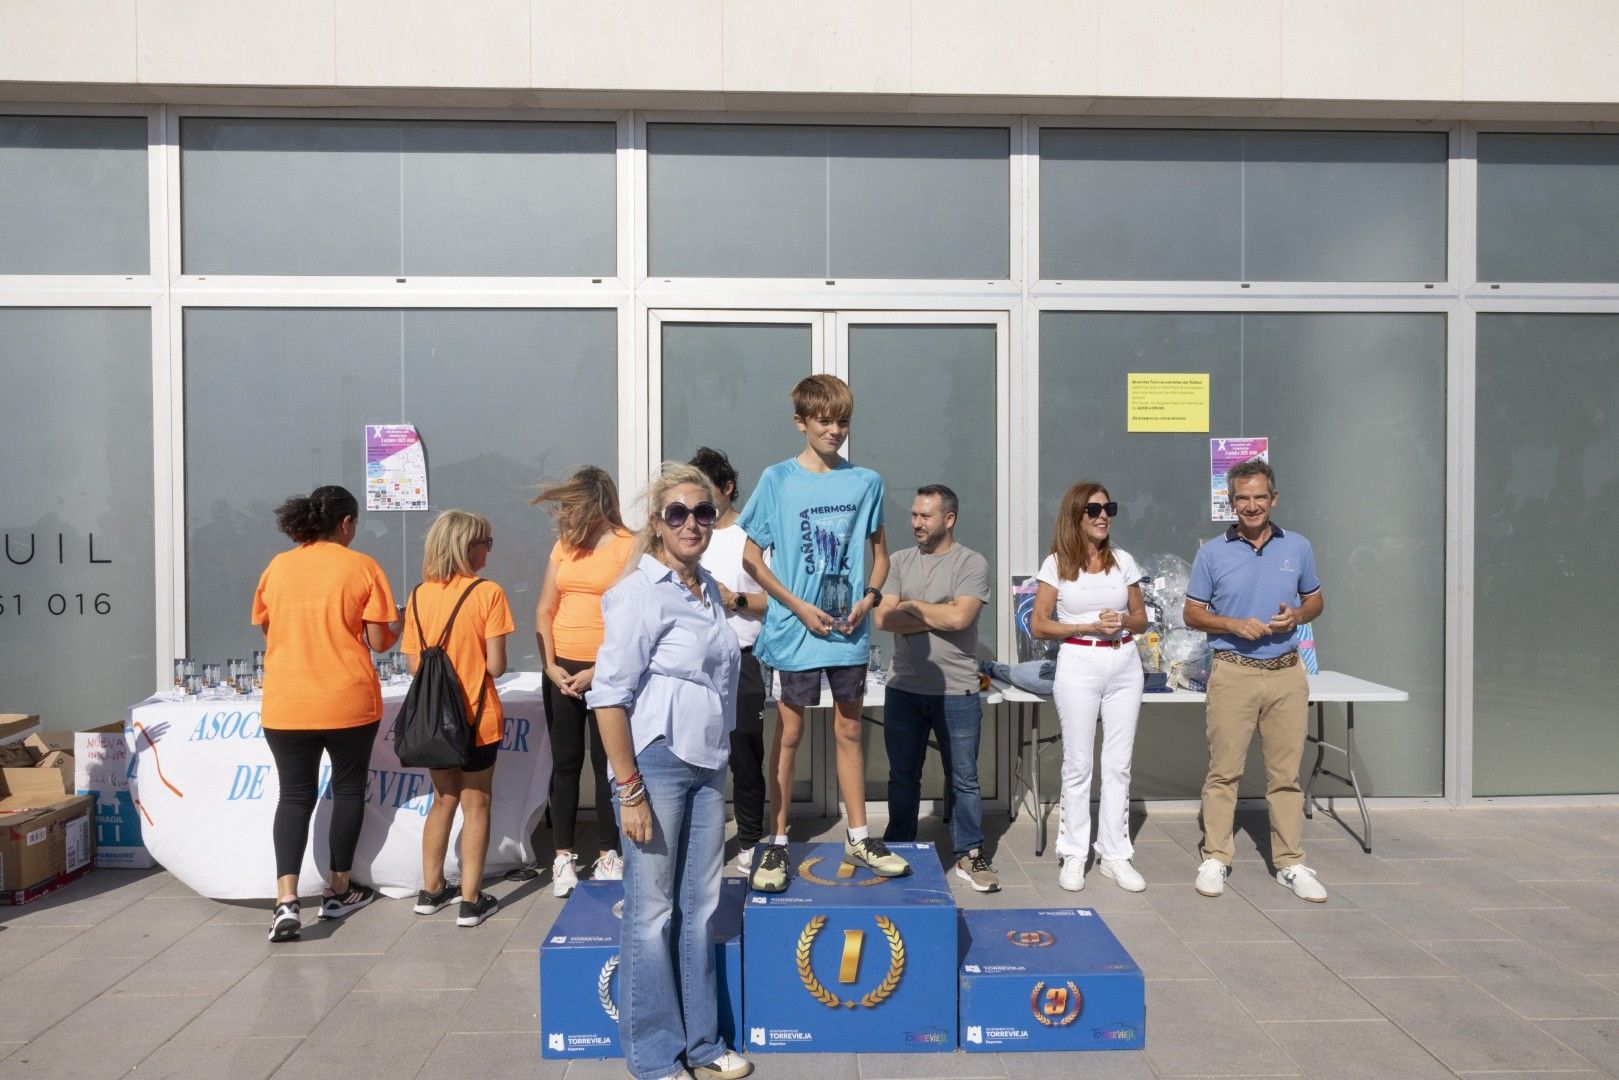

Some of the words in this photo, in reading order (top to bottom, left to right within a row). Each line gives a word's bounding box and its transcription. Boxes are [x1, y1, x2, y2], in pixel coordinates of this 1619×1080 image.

[811, 504, 857, 515] HERMOSA
[799, 508, 816, 575] CAÑADA
[48, 593, 111, 616] 016
[227, 765, 271, 800] DE
[1044, 988, 1068, 1015] 3
[568, 1037, 611, 1045] TORREVIEJA
